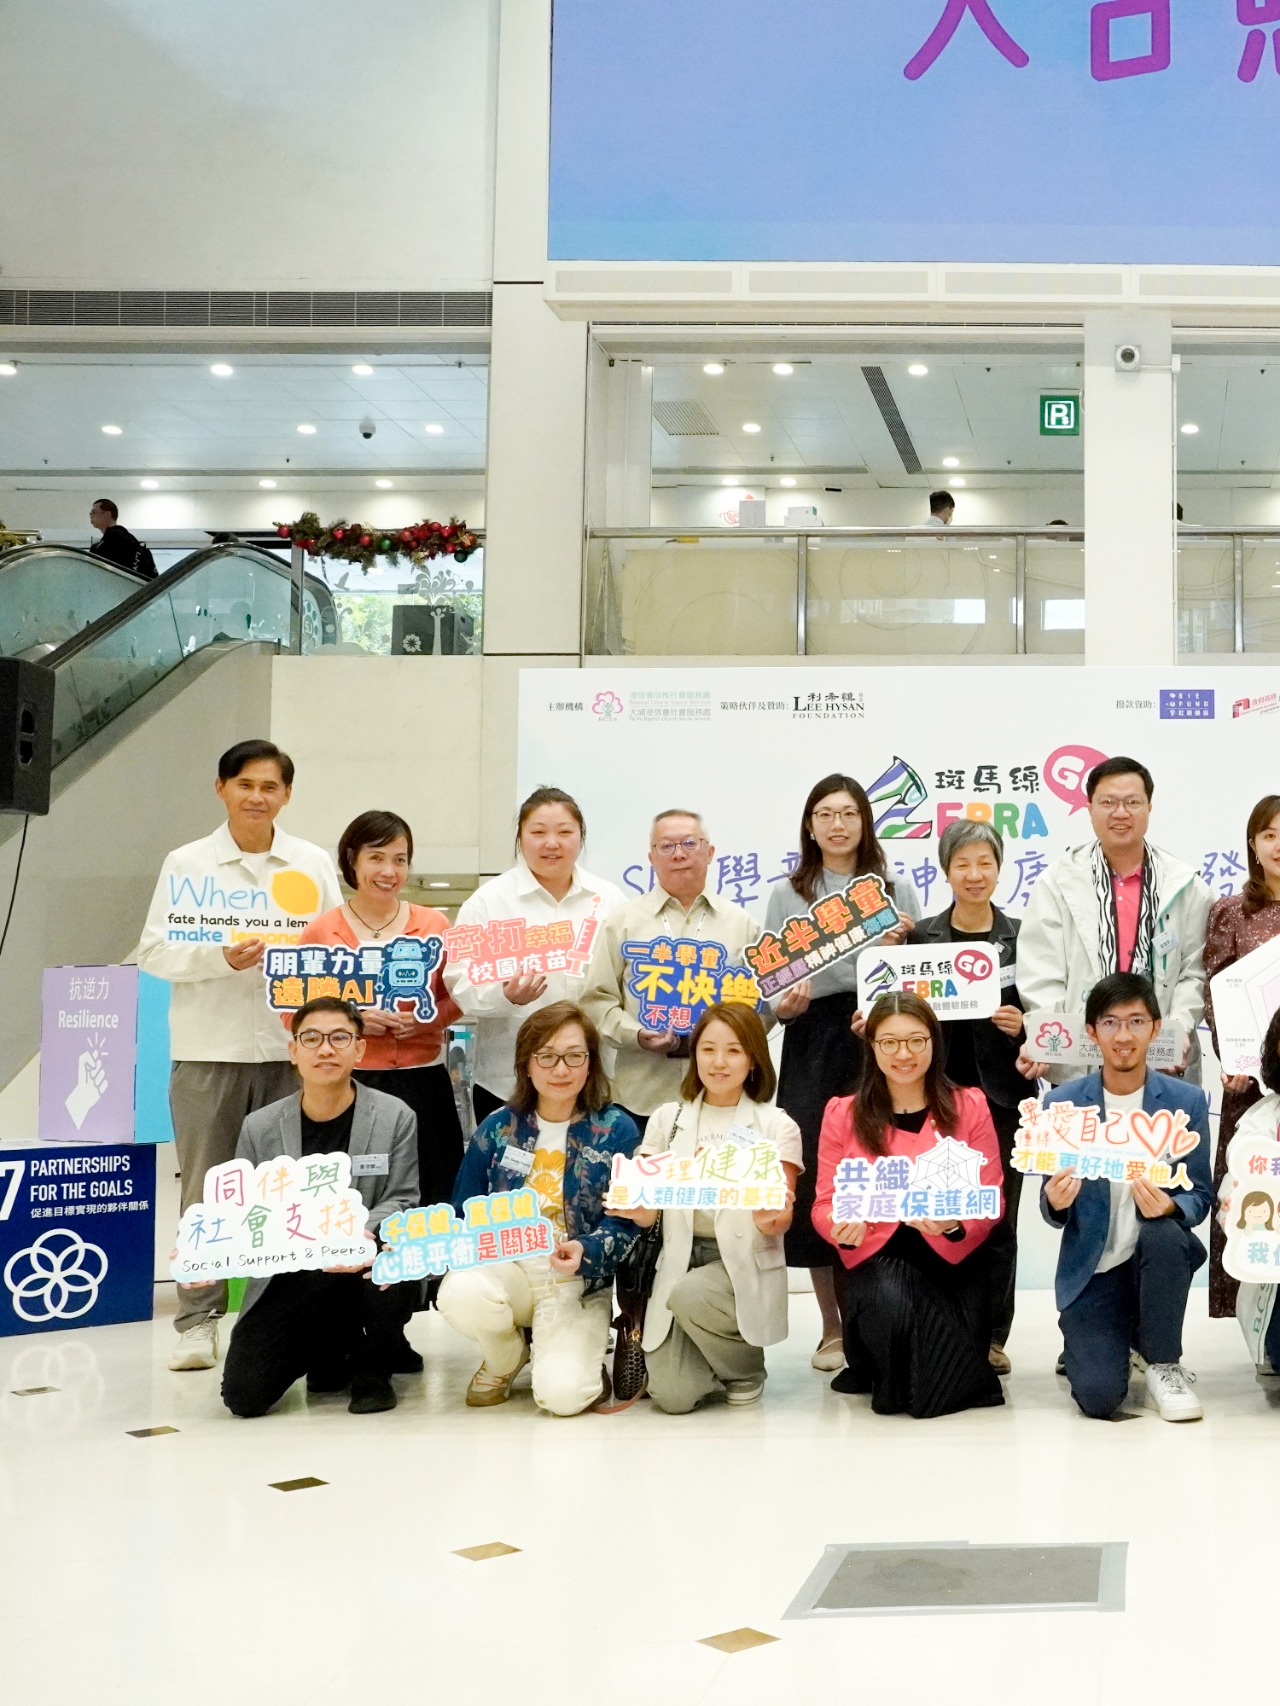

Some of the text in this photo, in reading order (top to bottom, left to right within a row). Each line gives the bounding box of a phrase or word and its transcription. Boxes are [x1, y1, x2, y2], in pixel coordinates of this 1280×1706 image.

[793, 696, 865, 711] LEE HYSAN
[935, 765, 1040, 794] 斑馬線
[168, 873, 269, 911] When
[168, 913, 196, 925] fate
[200, 914, 240, 926] hands
[245, 918, 270, 928] you
[274, 919, 282, 928] a
[168, 926, 223, 943] make
[748, 878, 888, 976] 近半學童
[269, 950, 385, 976] 朋輩力量
[470, 951, 567, 982] 校園疫苗
[626, 941, 721, 970] 一半學童
[900, 960, 953, 977] 斑馬線
[956, 953, 991, 978] GO
[69, 977, 110, 1001] 抗逆力
[635, 964, 761, 1009] 不快樂
[58, 1009, 119, 1030] Resilience
[30, 1155, 131, 1177] PARTNERSHIPS
[613, 1142, 782, 1186] 心理健康
[837, 1158, 911, 1192] 共織
[1013, 1148, 1192, 1189] 才能更好地愛他人
[30, 1179, 133, 1203] FOR THE GOALS
[214, 1161, 341, 1207] 同伴與
[609, 1184, 785, 1208] 是人類健康的基石
[30, 1200, 150, 1218] 促進目標實現的夥伴關係
[835, 1188, 1000, 1222] 家庭保護網
[187, 1200, 357, 1251] 社會支持
[181, 1244, 366, 1274] Social Support & Peers
[376, 1223, 550, 1282] 心態平衡是關鍵
